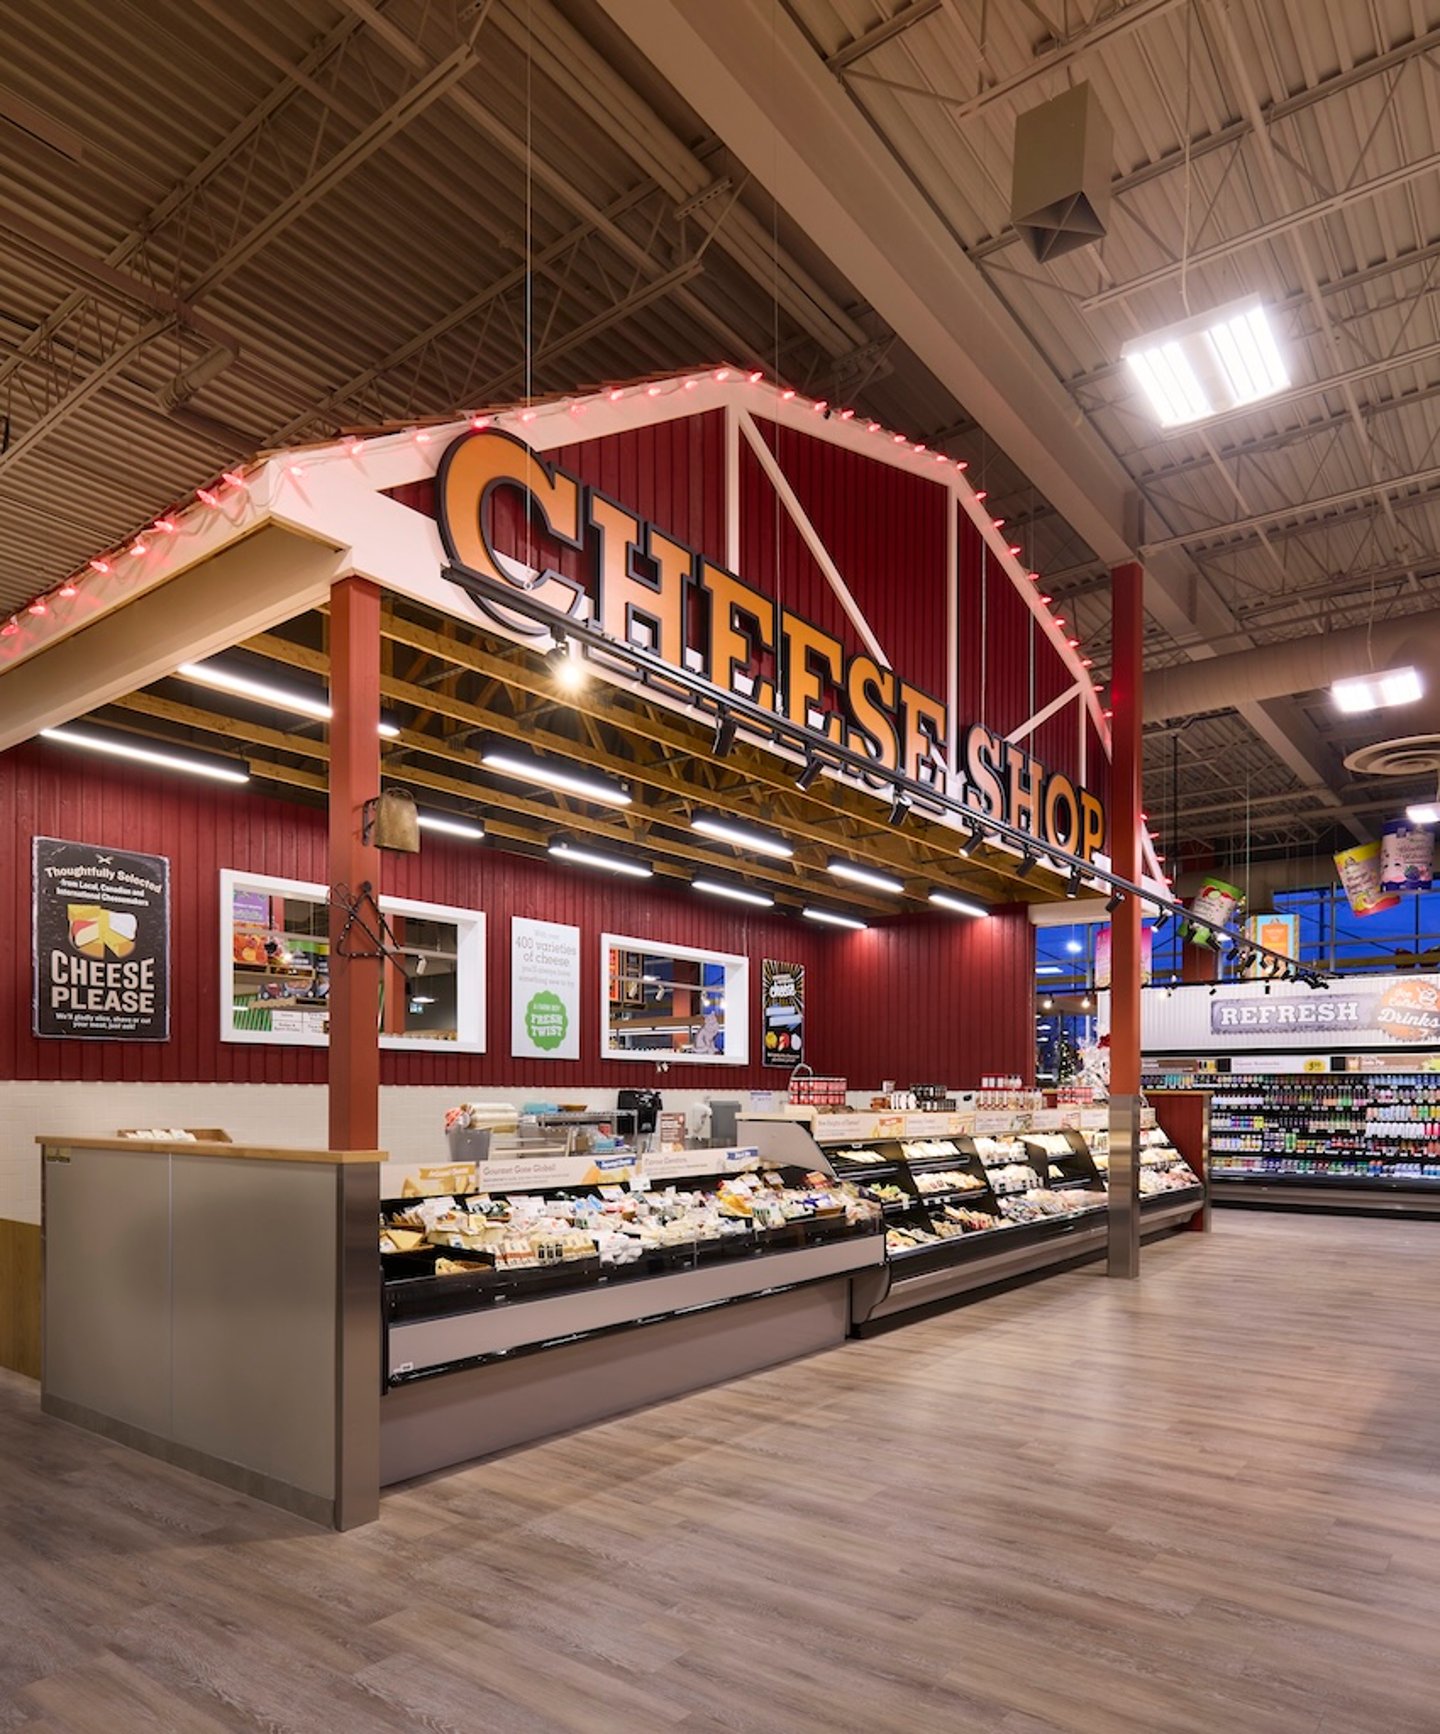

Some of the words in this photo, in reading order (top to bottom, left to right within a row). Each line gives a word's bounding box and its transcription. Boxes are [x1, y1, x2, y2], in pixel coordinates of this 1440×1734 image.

[436, 426, 949, 816] CHEESE
[963, 722, 1105, 884] SHOP
[44, 865, 116, 880] Thoughtfully
[116, 870, 162, 894] Selected
[60, 878, 79, 888] from
[100, 883, 131, 895] Canadian
[132, 889, 145, 898] and
[56, 886, 100, 901] International
[100, 892, 150, 907] Cheesemakers
[515, 936, 534, 949] 400
[535, 941, 577, 956] varieties
[523, 950, 534, 962] of
[535, 952, 570, 968] cheese
[51, 949, 155, 991] CHEESE
[51, 985, 155, 1014] PLEASE
[531, 1013, 563, 1026] FRESH
[1220, 1002, 1358, 1026] REFRESH
[1377, 1007, 1440, 1028] Drinks
[531, 1025, 563, 1038] TWIST
[483, 1165, 513, 1177] Gourmet
[514, 1164, 532, 1174] Gone
